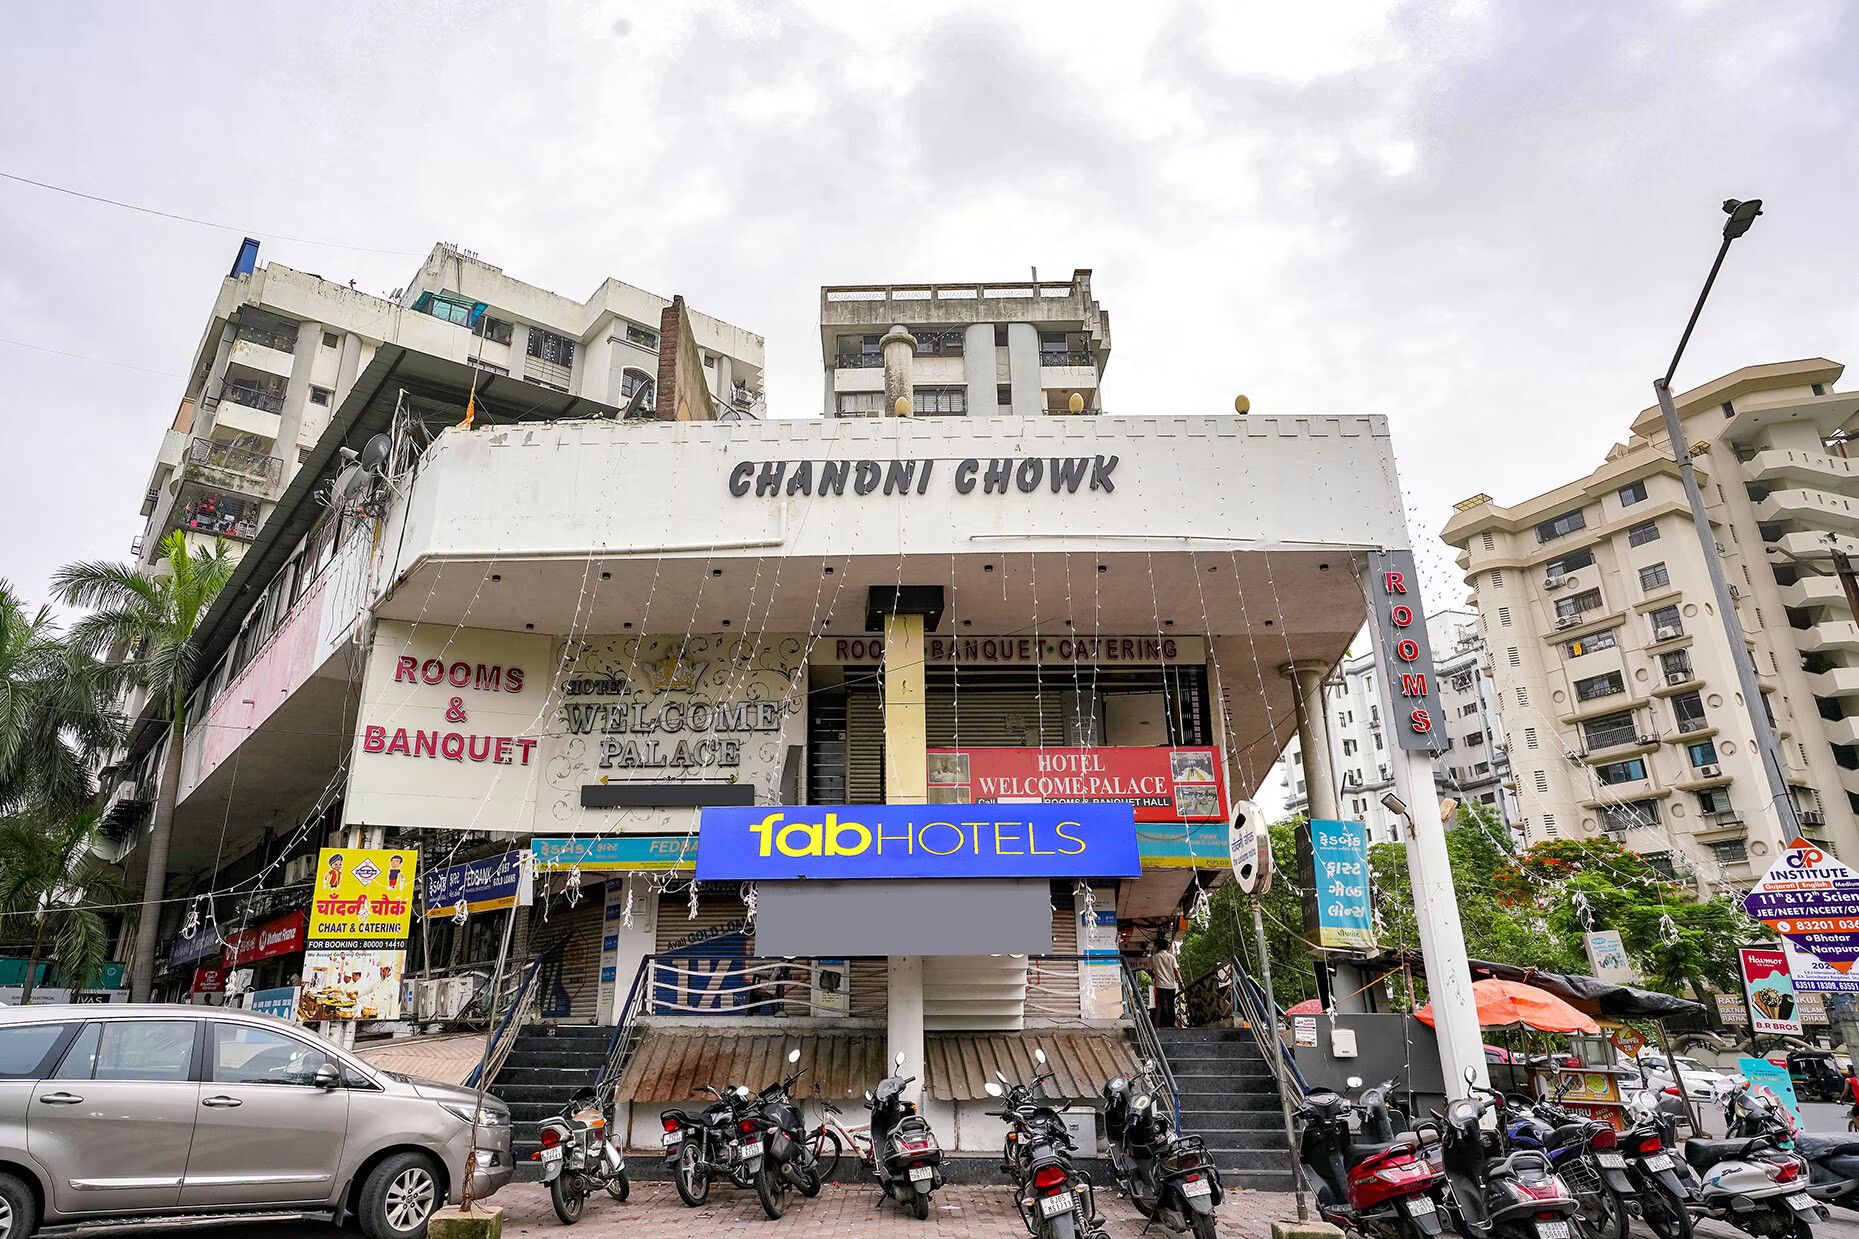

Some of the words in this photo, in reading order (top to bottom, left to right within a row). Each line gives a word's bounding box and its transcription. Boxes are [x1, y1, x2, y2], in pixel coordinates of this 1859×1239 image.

[729, 460, 934, 498] CHANDNI
[954, 454, 1120, 495] CHOWK
[836, 639, 885, 660] ROO
[931, 640, 1048, 660] BANQUET
[1060, 639, 1178, 660] CATERING
[1385, 571, 1432, 733] ROOMS
[394, 655, 526, 694] ROOMS
[566, 679, 632, 696] HOTEL
[445, 697, 467, 722] &
[566, 701, 783, 735] WELCOME
[363, 725, 538, 766] BANQUET
[601, 739, 740, 767] PALACE
[1038, 754, 1106, 772] HOTEL
[978, 777, 1085, 796] WELCOME
[1090, 776, 1168, 795] PALACE
[1143, 798, 1170, 806] HALL
[649, 840, 700, 854] FEDBA
[1770, 868, 1849, 880] INSTITUTE
[1802, 881, 1828, 889] English
[317, 893, 368, 916] चाँदनी
[371, 893, 407, 916] चौक
[318, 922, 347, 933] CHAAT
[349, 922, 356, 933] &
[358, 923, 401, 933] CATERING
[1796, 920, 1834, 930] 83201
[308, 940, 324, 949] FOR
[325, 940, 358, 949] BOOKING
[363, 941, 383, 949] 80000
[385, 941, 405, 949] 14410
[1813, 934, 1850, 942] Bhatar
[1748, 955, 1782, 965] Havmor
[1795, 981, 1816, 990] 63518
[1756, 1022, 1771, 1030] B.R
[1773, 1023, 1799, 1032] BROS
